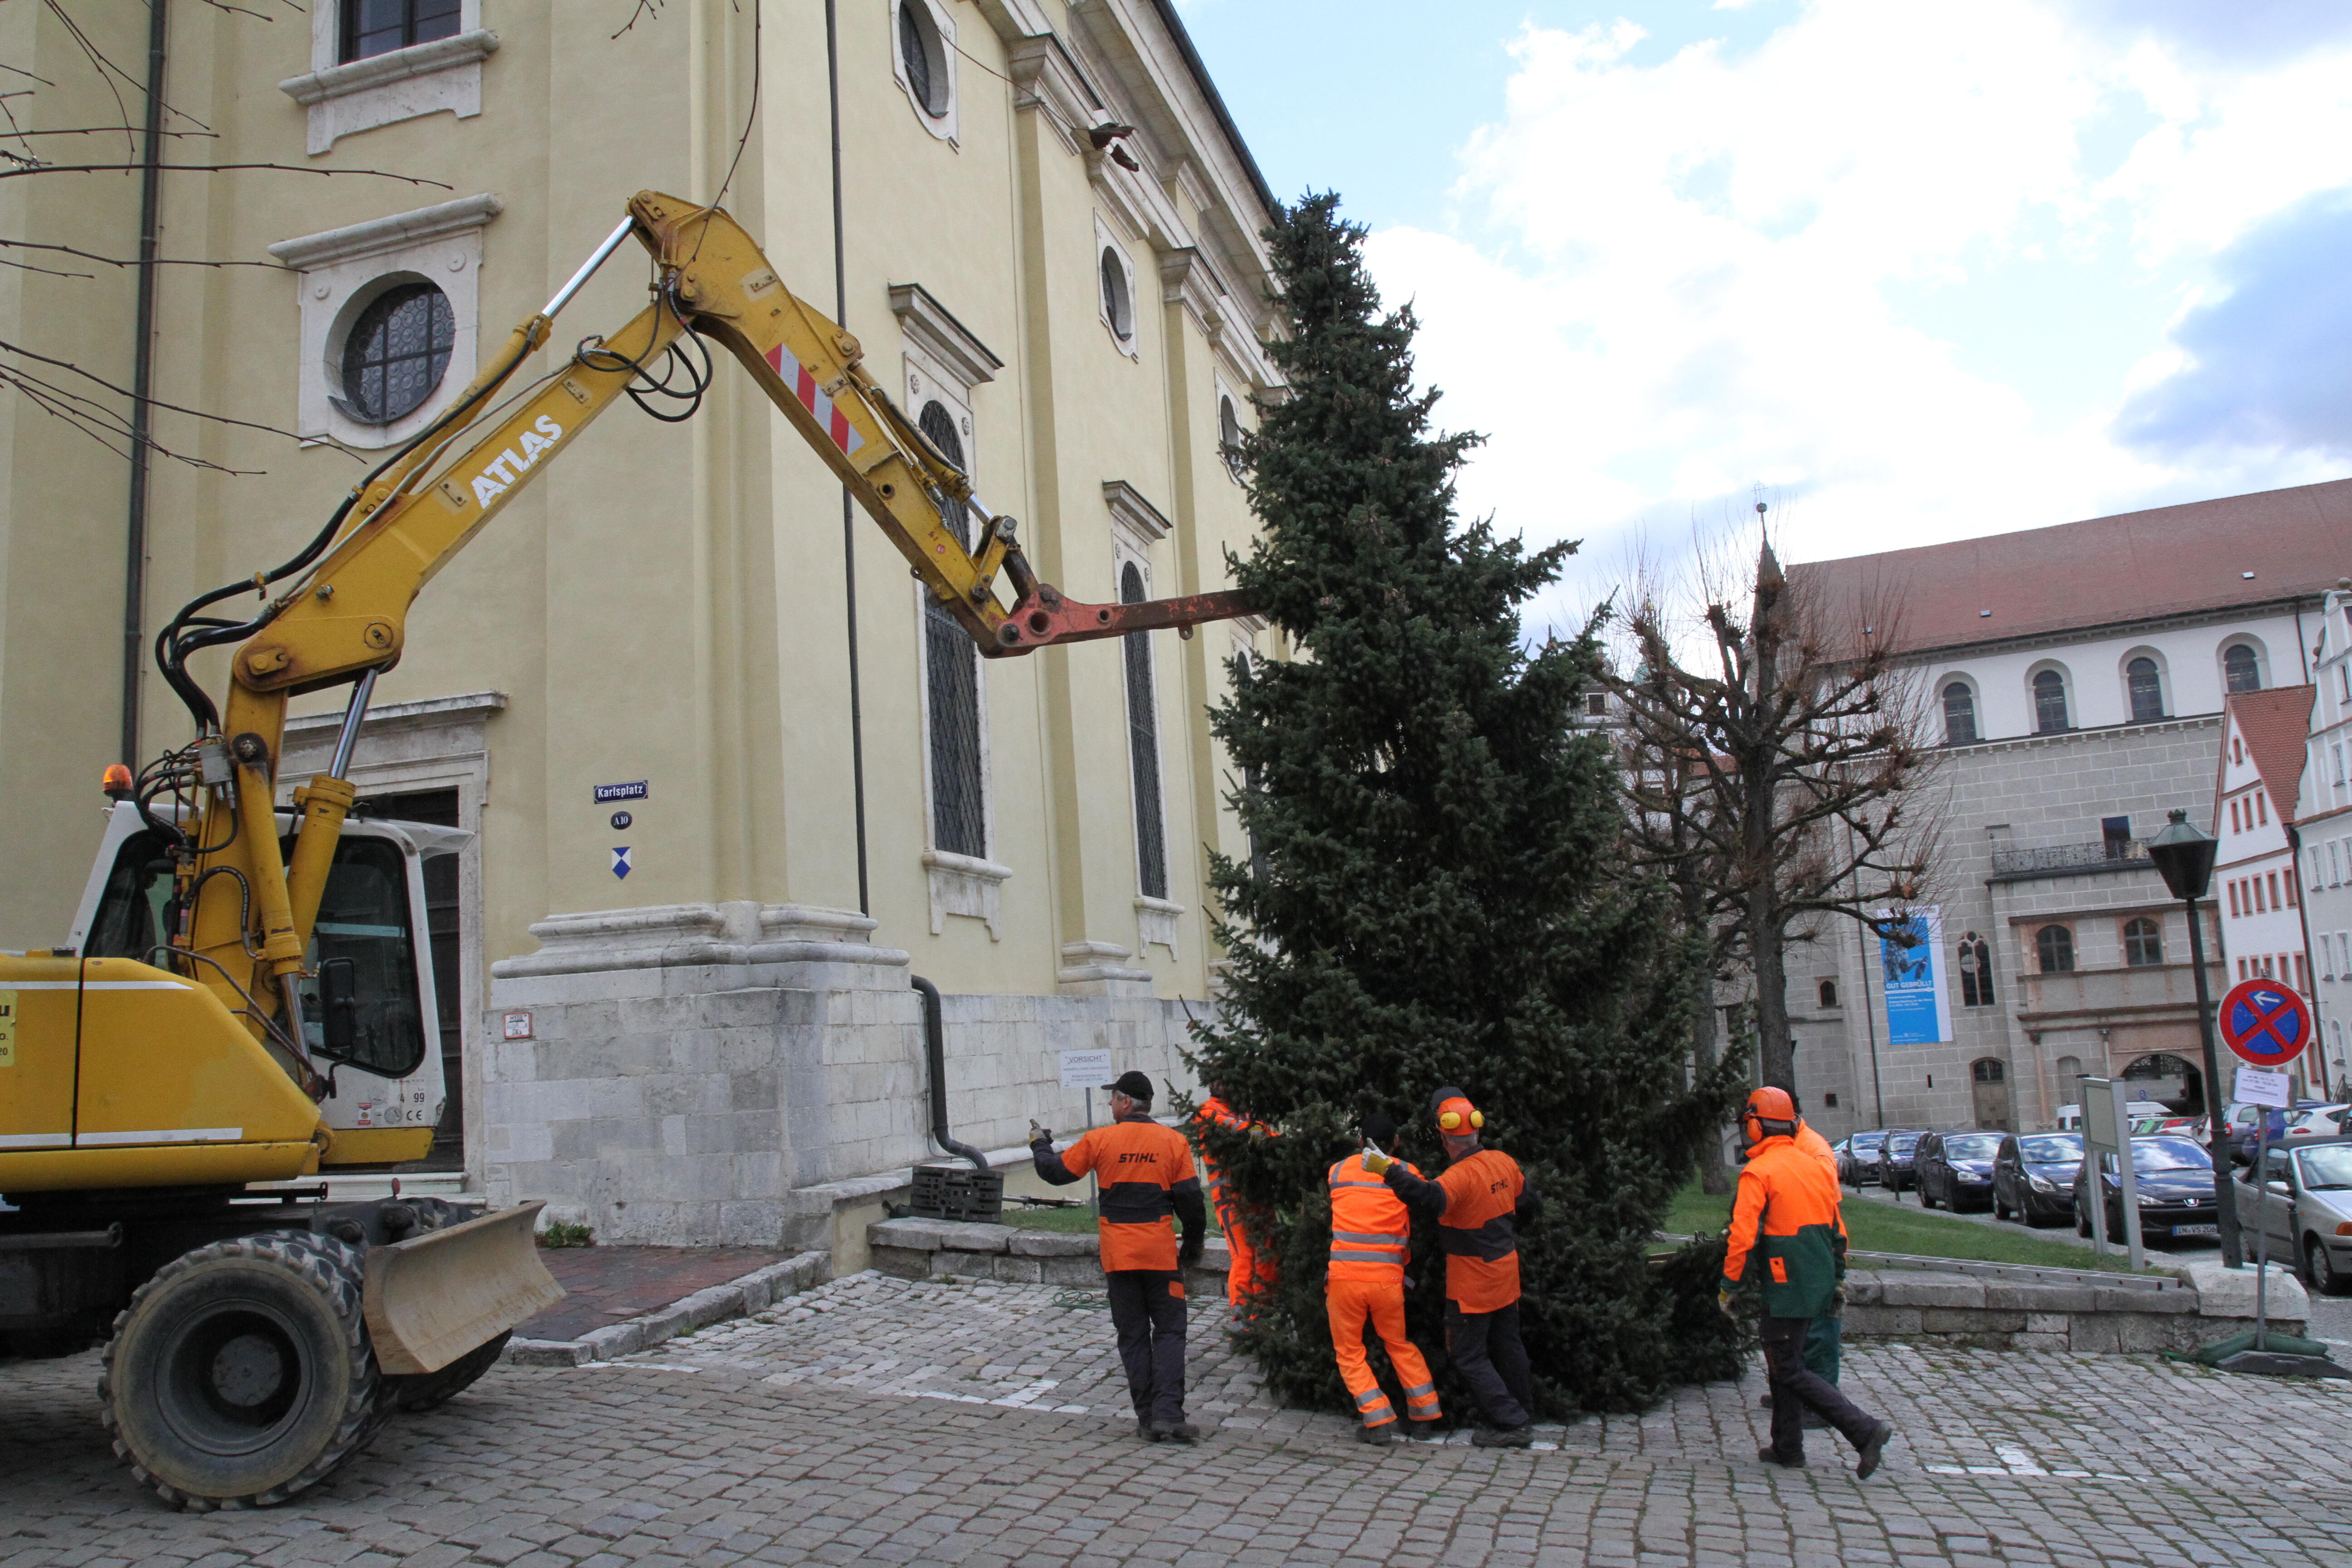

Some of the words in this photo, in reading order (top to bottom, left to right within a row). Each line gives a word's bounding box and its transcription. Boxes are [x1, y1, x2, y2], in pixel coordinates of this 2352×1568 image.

[471, 415, 563, 509] ATLAS
[598, 785, 643, 798] Karlsplatz
[1901, 980, 1932, 988] GEBRÜLLT
[414, 1093, 425, 1102] 99
[1118, 1153, 1157, 1163] STIHL
